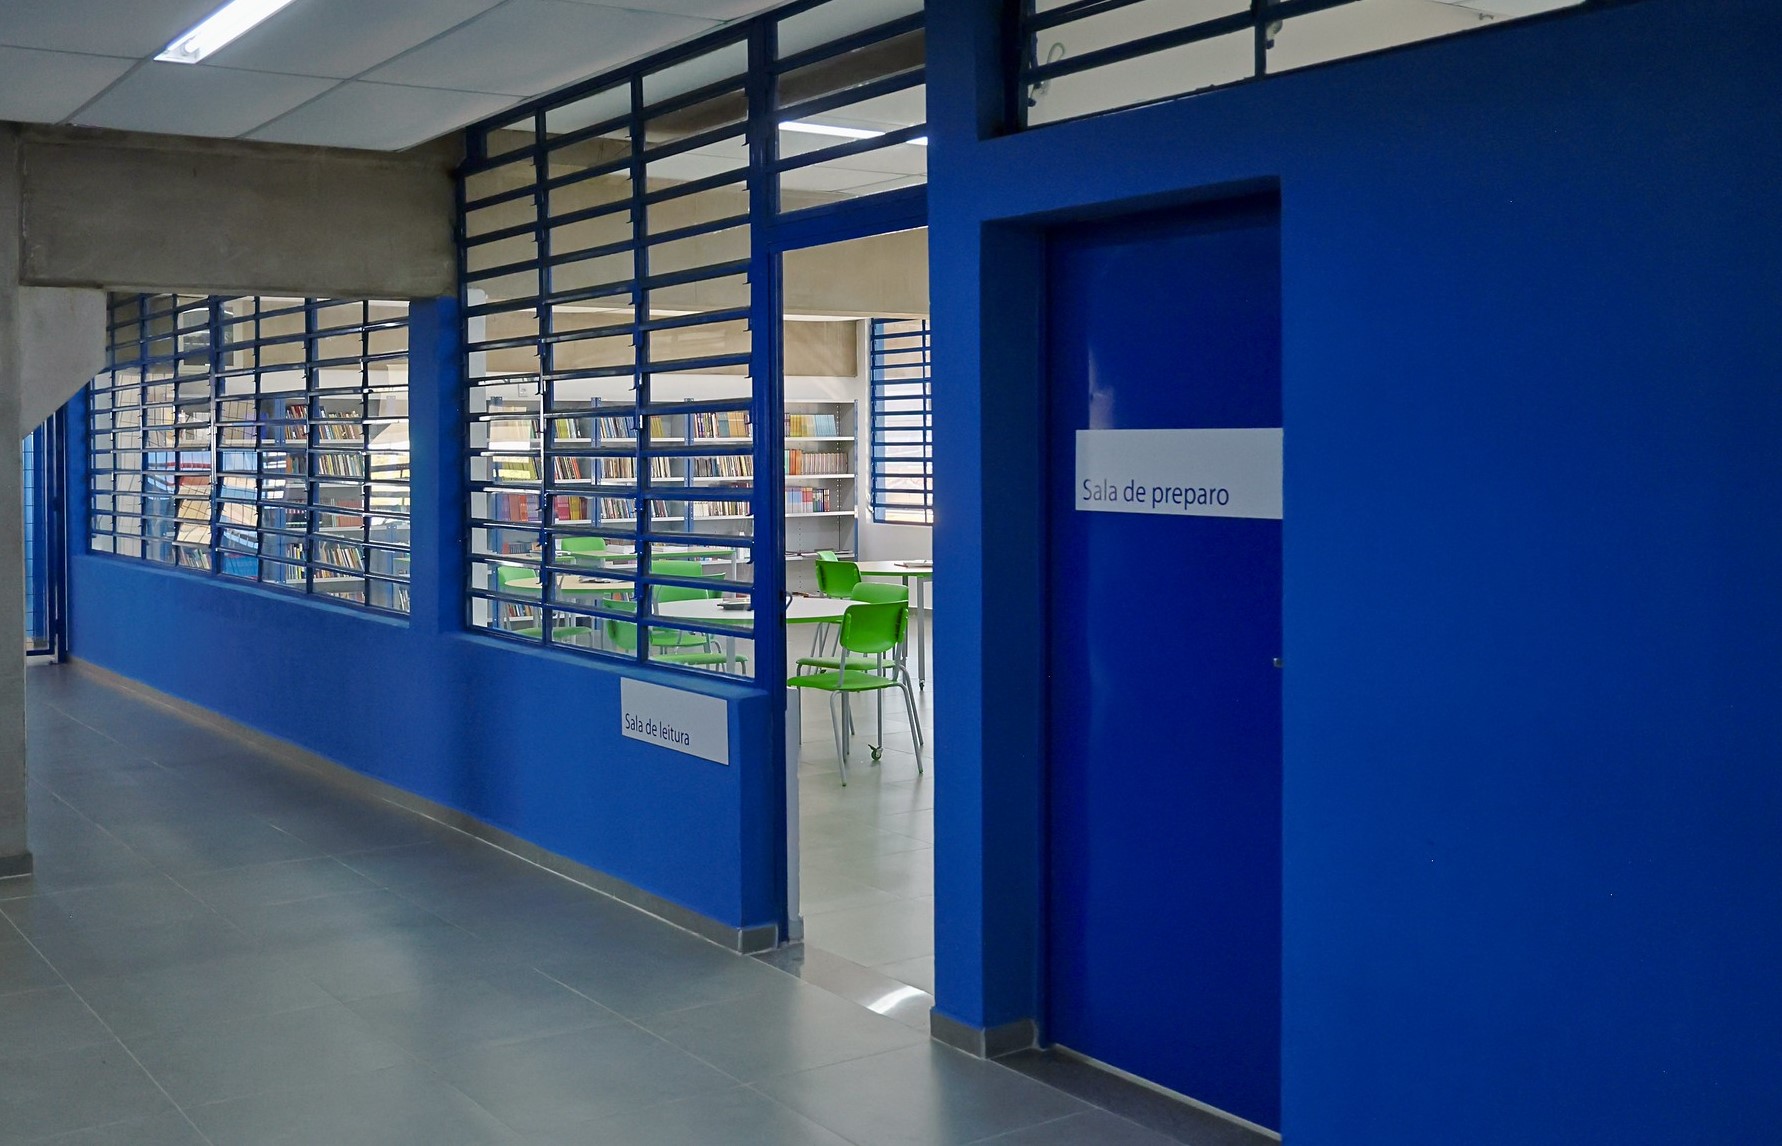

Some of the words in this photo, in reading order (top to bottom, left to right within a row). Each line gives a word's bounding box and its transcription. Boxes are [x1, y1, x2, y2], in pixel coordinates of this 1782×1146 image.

[1083, 478, 1117, 501] Sala
[1123, 479, 1146, 503] de
[1152, 486, 1230, 510] preparo
[625, 713, 643, 733] Sala
[645, 718, 658, 737] de
[660, 721, 690, 746] leitura
